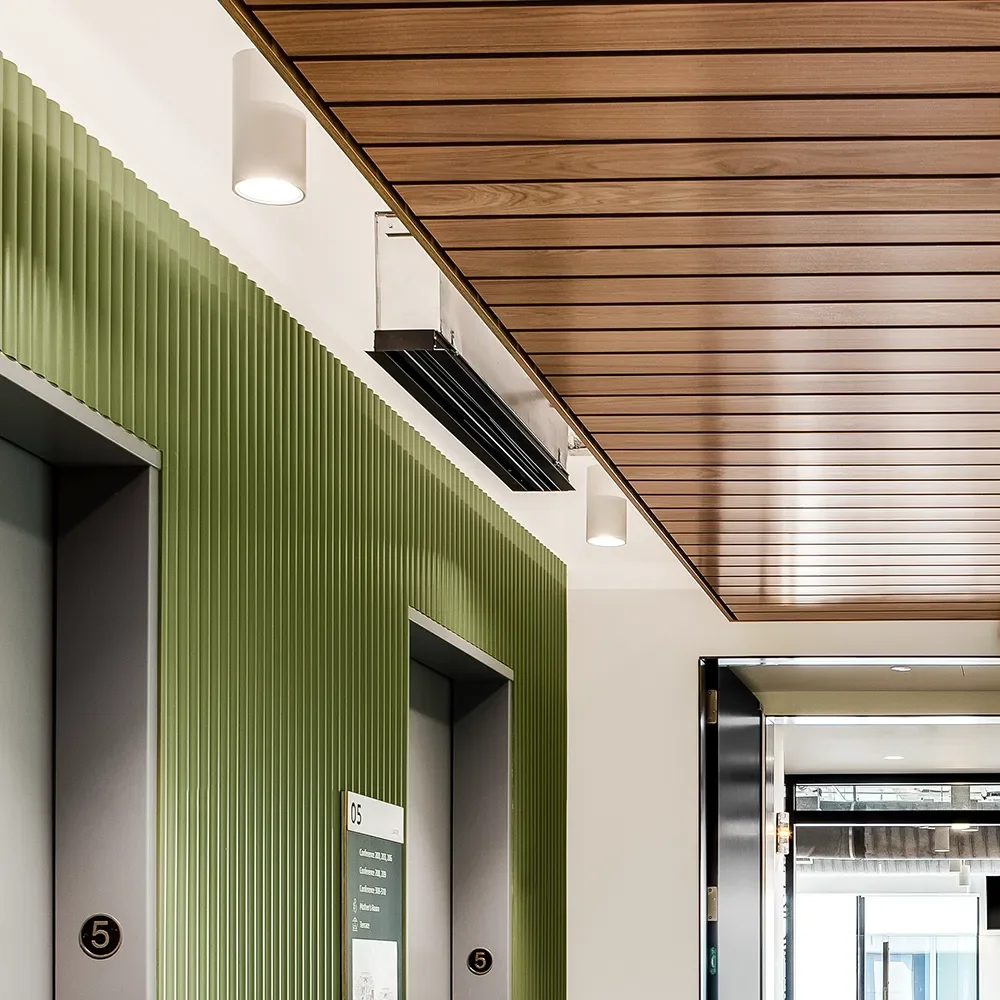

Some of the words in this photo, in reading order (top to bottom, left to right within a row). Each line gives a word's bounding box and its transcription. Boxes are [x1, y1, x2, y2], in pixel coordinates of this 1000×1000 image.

[350, 802, 362, 825] 05
[91, 920, 110, 949] 5
[475, 951, 486, 969] 5
